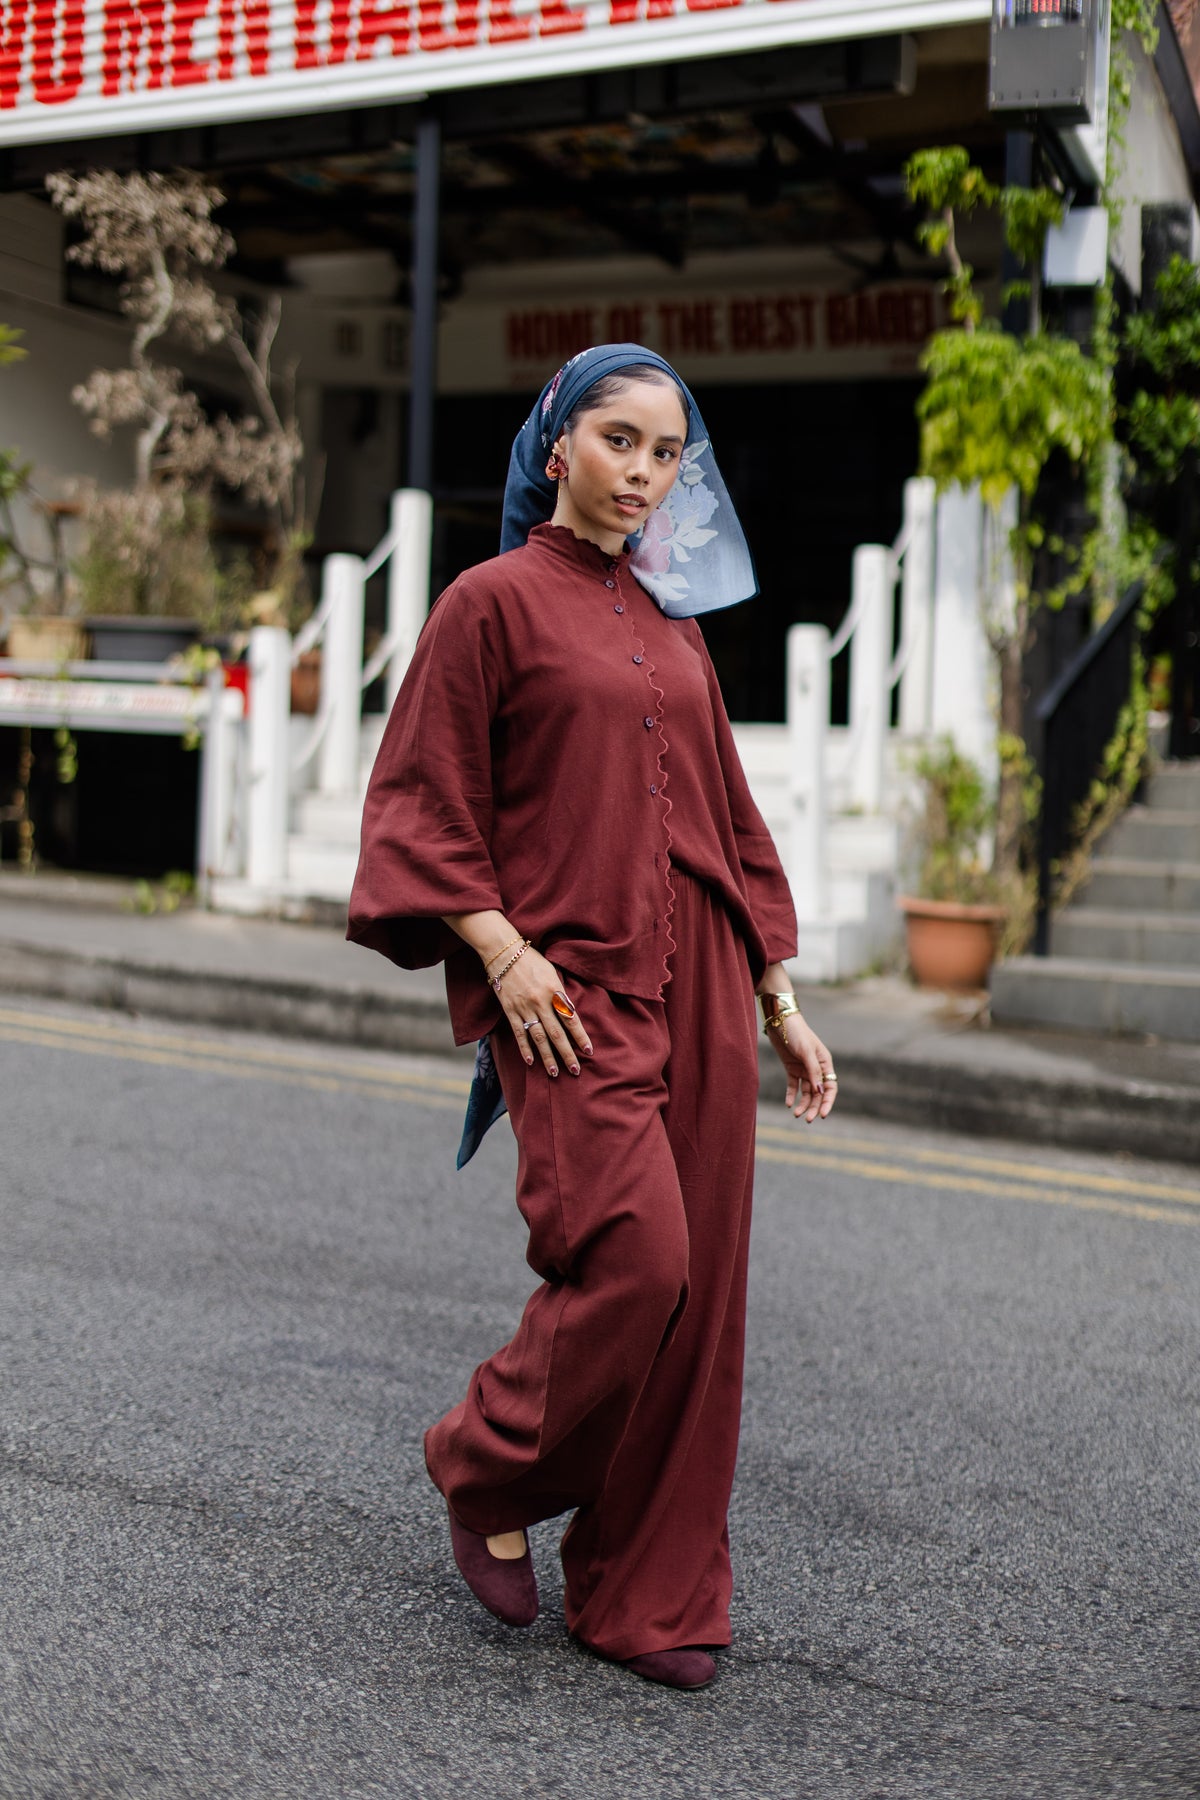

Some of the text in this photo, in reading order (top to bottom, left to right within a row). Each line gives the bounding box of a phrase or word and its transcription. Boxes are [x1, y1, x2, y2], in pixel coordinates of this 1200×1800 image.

[507, 305, 597, 359] HOME
[608, 303, 650, 344] OF
[657, 299, 723, 353] THE
[728, 295, 814, 351] BEST
